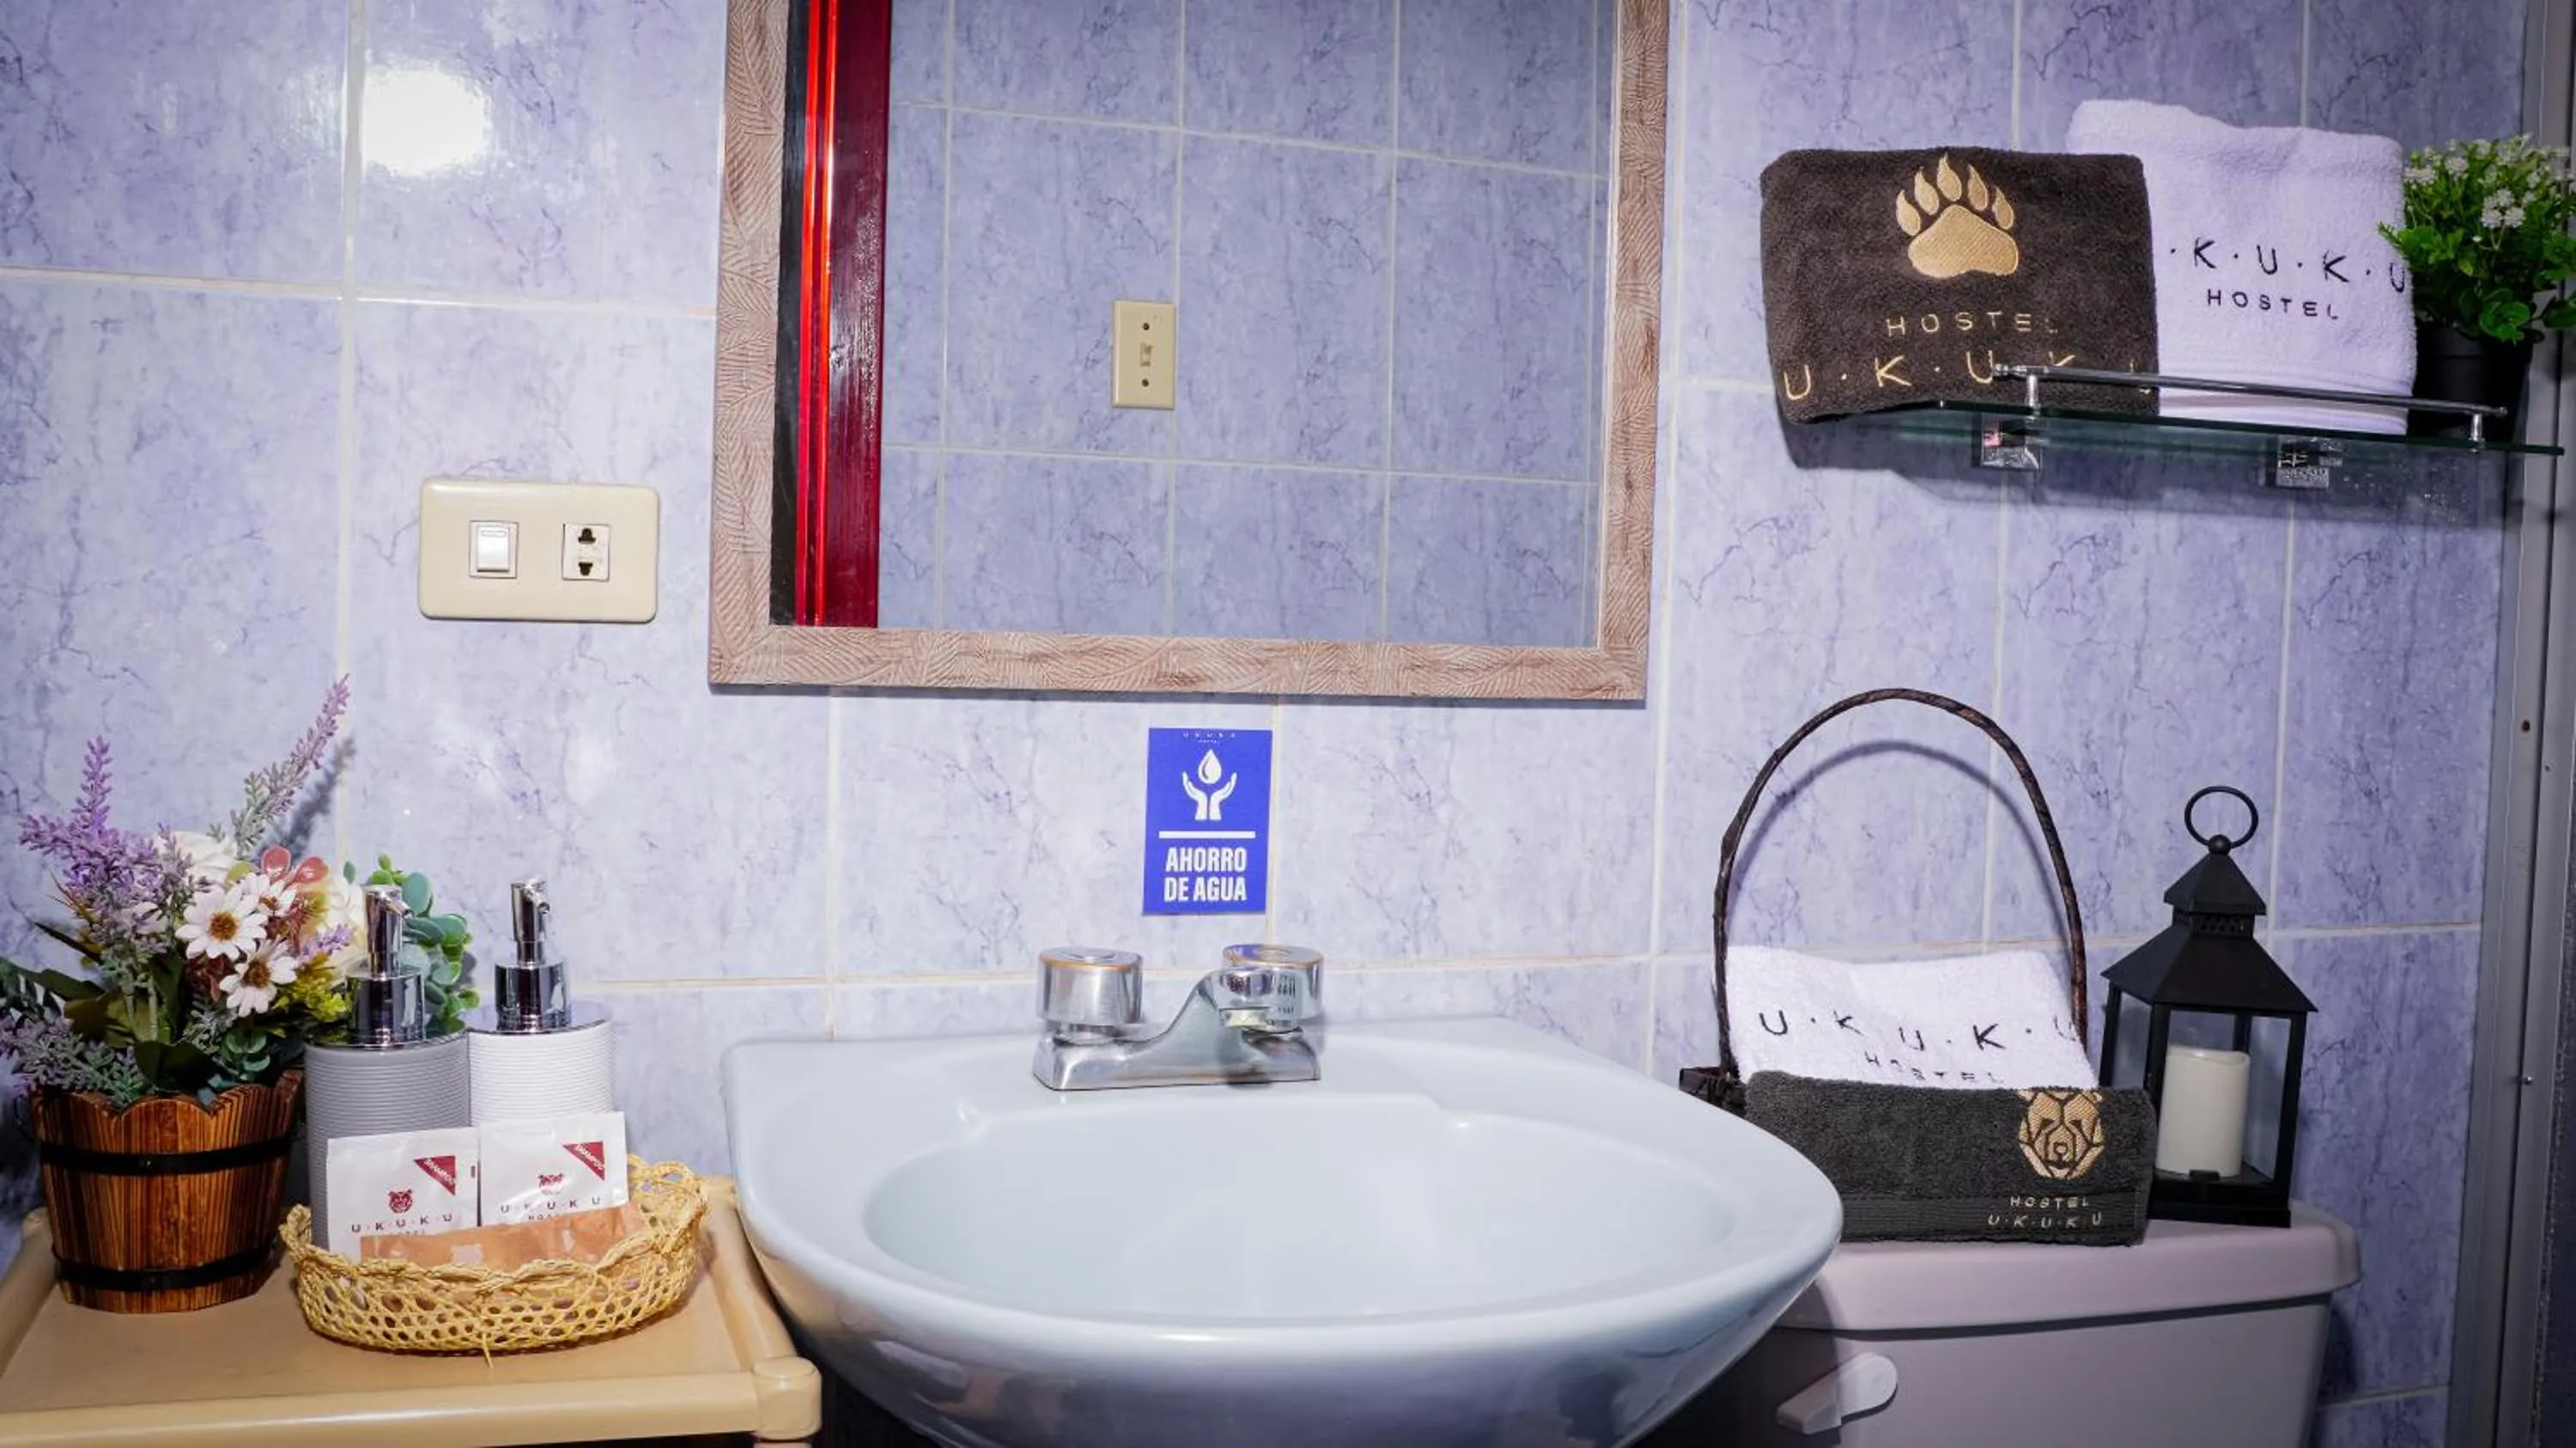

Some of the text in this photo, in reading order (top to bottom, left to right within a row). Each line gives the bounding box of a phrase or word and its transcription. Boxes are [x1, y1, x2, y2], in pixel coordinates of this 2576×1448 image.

[2206, 289, 2340, 320] HOSTEL
[1165, 847, 1247, 873] AHORRO
[1163, 876, 1247, 903] DE AGUA
[2009, 1196, 2089, 1210] HOSTEL
